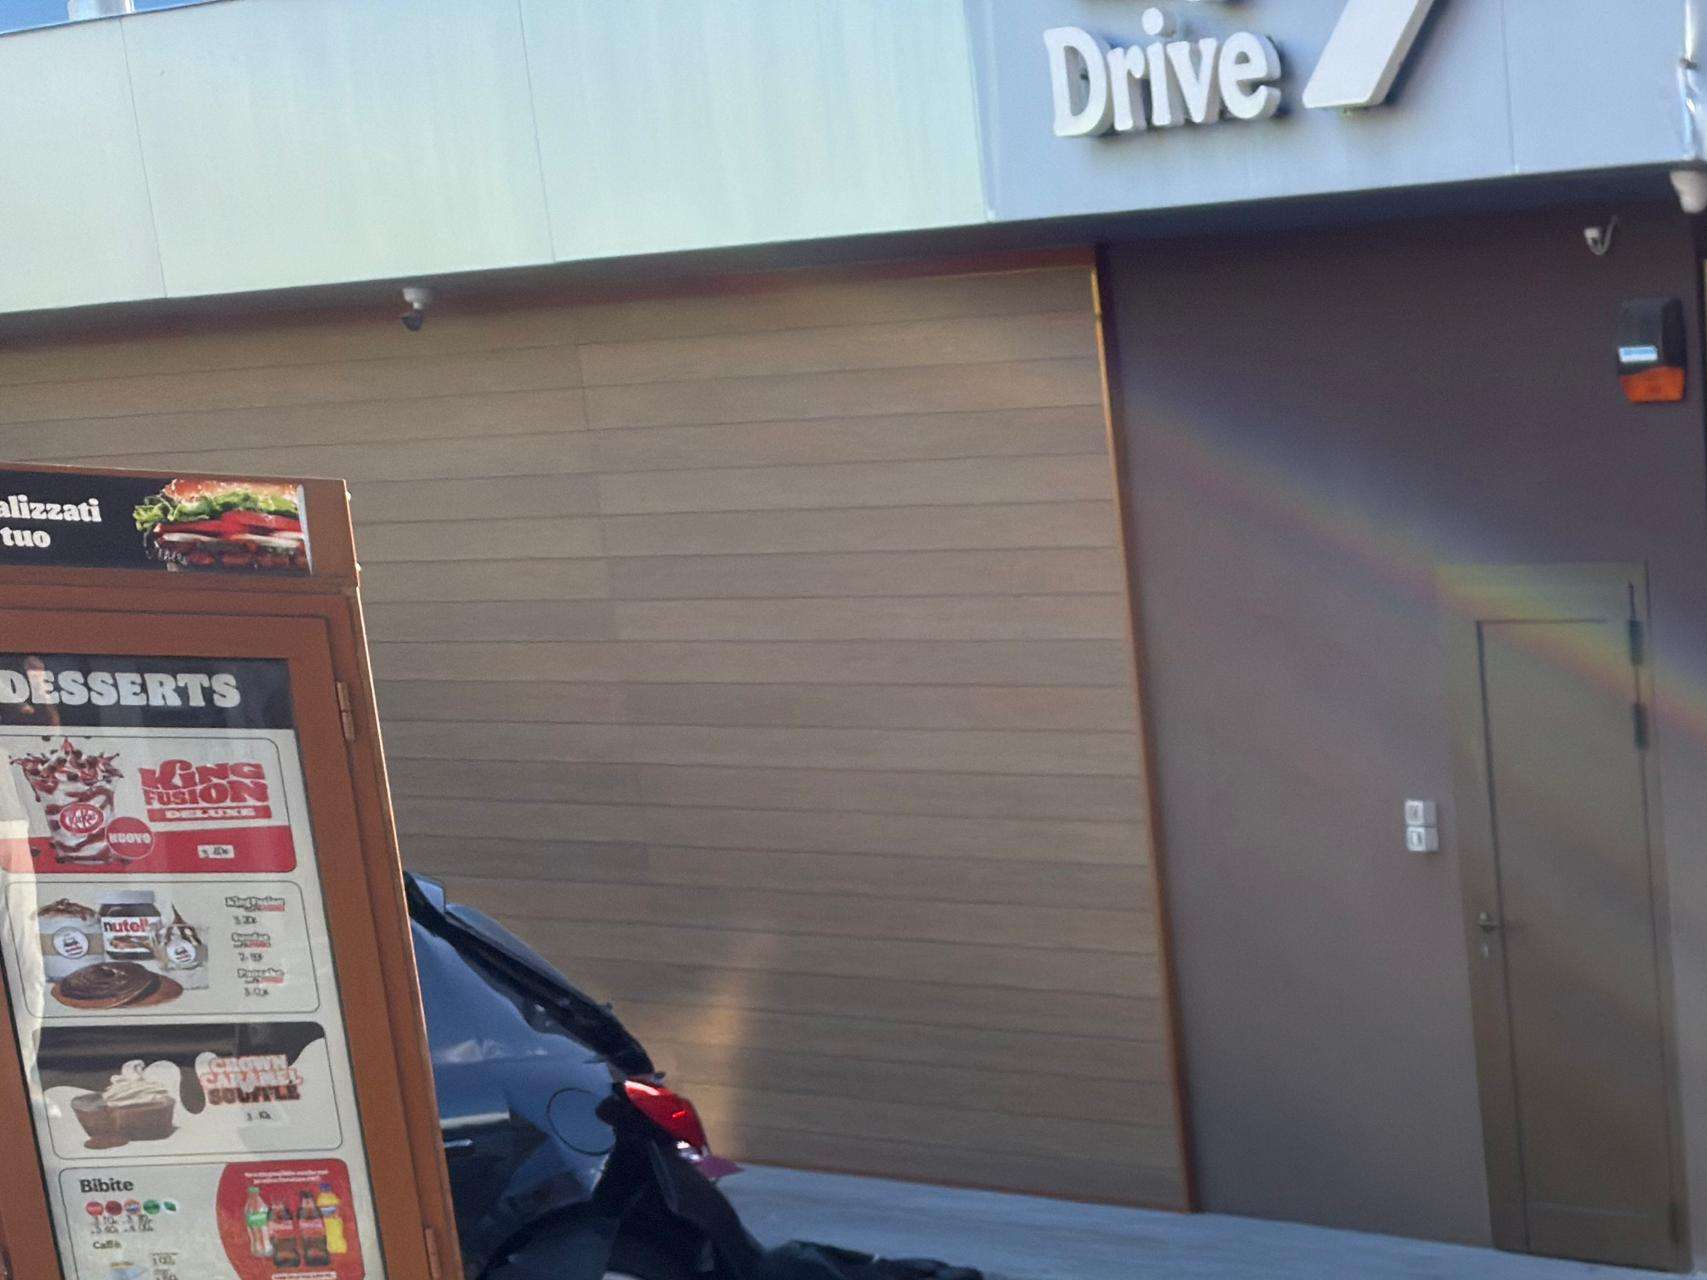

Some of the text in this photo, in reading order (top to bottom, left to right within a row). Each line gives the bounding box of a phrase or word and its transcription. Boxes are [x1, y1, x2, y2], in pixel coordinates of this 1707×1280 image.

[1043, 7, 1282, 137] Drive
[0, 526, 51, 548] tuo
[0, 669, 241, 708] DESSERTS
[103, 918, 158, 933] nutell
[80, 1178, 134, 1192] Bibite
